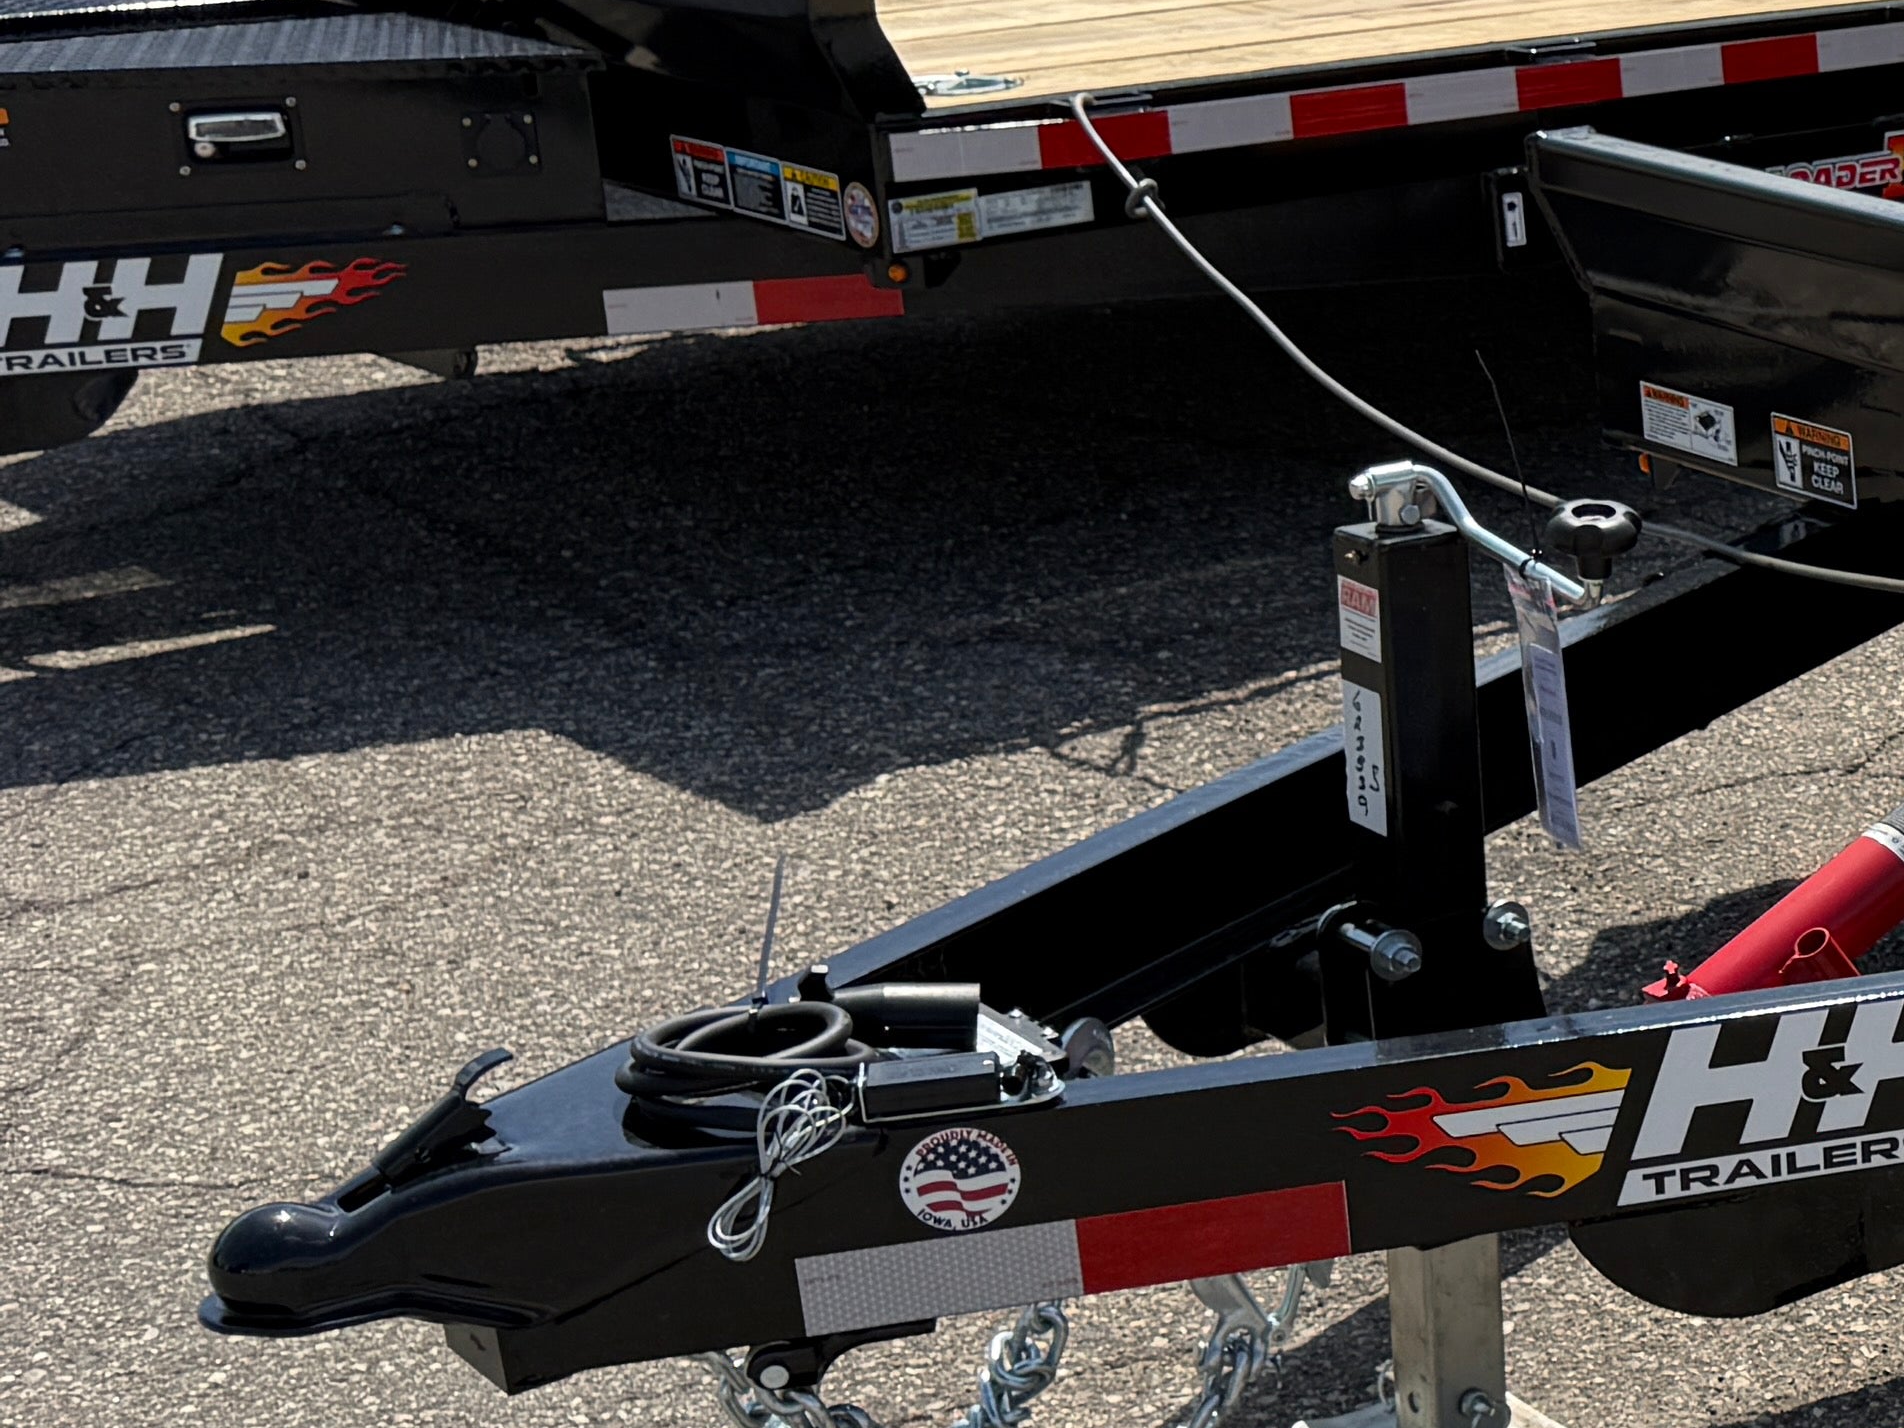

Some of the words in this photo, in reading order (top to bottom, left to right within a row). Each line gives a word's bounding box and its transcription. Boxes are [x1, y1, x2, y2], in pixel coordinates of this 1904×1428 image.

[0, 344, 188, 371] RAILERS
[1813, 461, 1839, 478] KEEP
[1811, 474, 1844, 495] CLEAR
[915, 1129, 977, 1158] PROUDLY
[977, 1130, 1006, 1154] MADE
[1005, 1150, 1018, 1167] IN
[917, 1208, 956, 1231] IOWA,
[961, 1214, 989, 1229] USA
